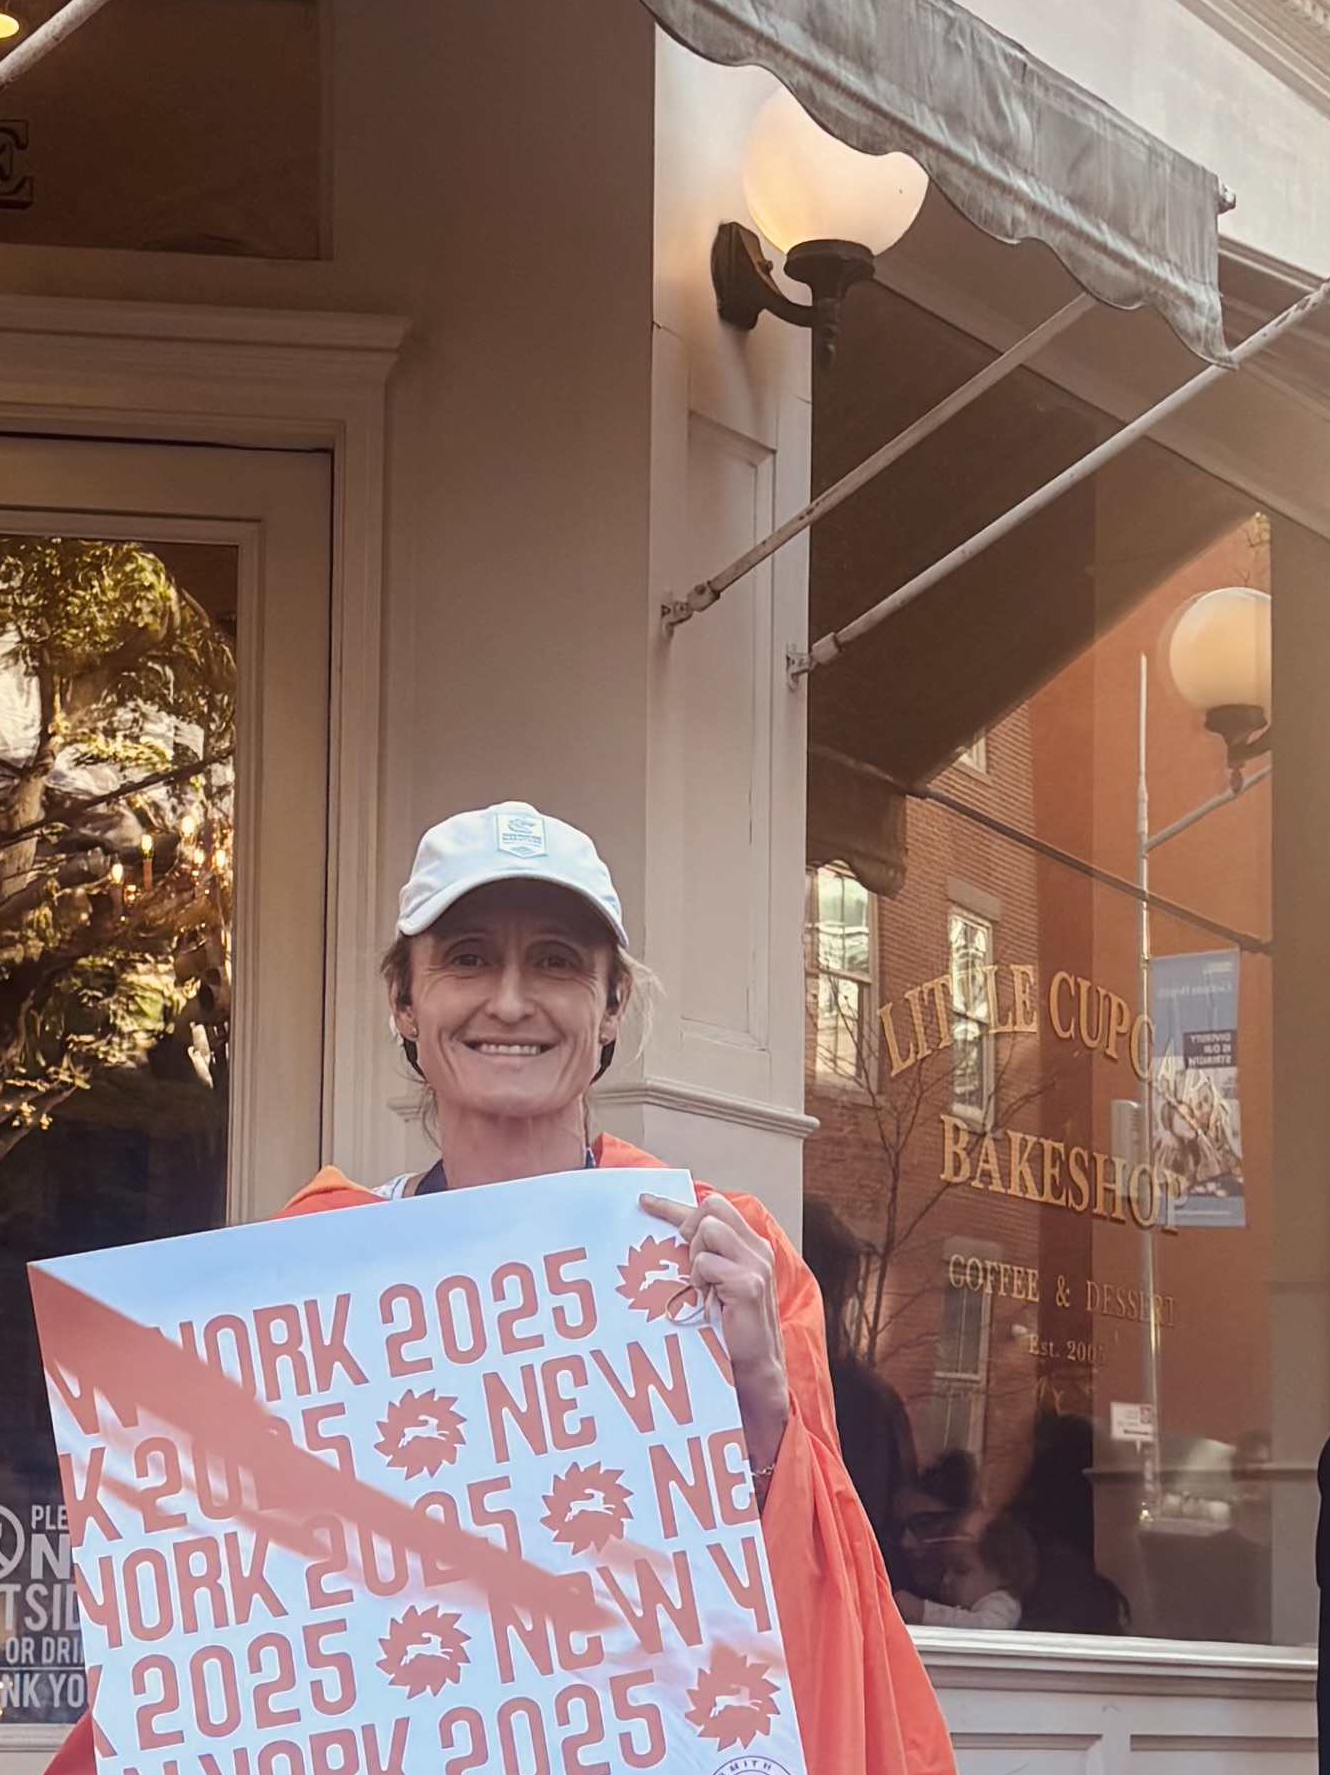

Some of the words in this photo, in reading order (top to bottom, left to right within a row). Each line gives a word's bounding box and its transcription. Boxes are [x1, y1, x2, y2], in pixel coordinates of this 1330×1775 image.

[878, 964, 1038, 1077] LITLE
[940, 1114, 1187, 1236] BAKESHOP
[379, 1247, 598, 1378] 2025
[949, 1253, 1040, 1303] COFFEE
[1086, 1280, 1175, 1327] DESSERT
[134, 1402, 357, 1534] 205
[483, 1332, 694, 1464] NEW
[73, 1530, 289, 1649] YORK
[131, 1618, 359, 1751] 2025
[706, 1536, 774, 1634] Y
[5, 1637, 35, 1665] OR
